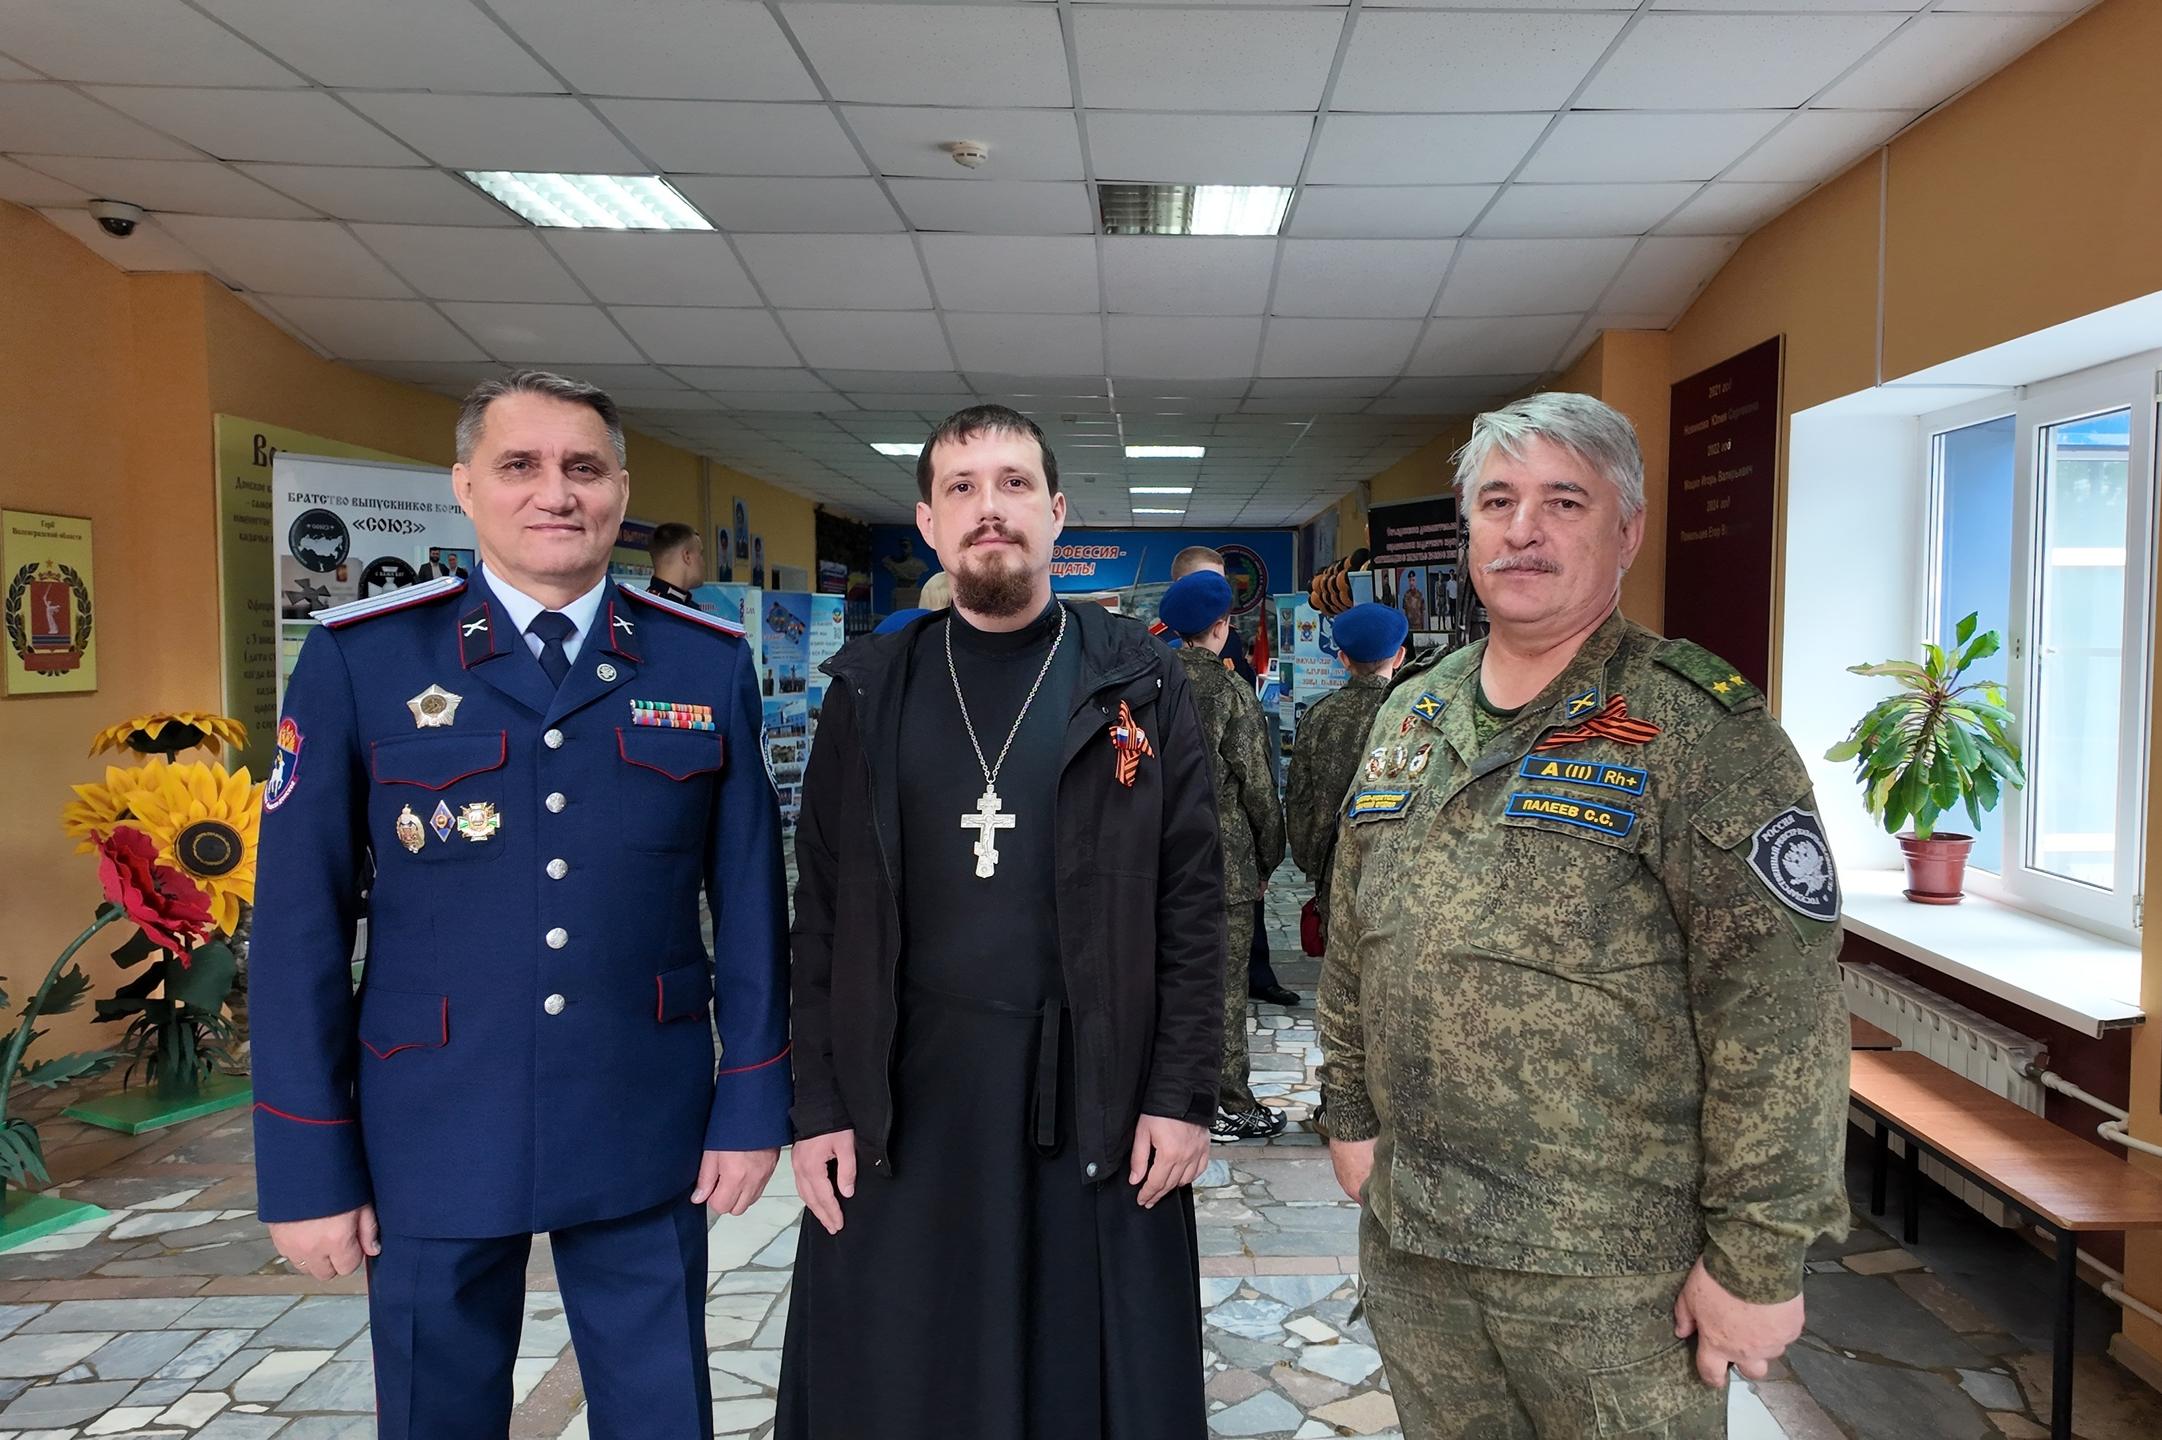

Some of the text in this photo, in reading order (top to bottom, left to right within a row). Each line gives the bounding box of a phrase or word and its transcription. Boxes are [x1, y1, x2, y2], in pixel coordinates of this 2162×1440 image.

[287, 492, 349, 506] БРАТСТВО
[351, 497, 434, 512] ВЫПУСКНИКОВ
[352, 517, 426, 534] «СОЮЗ»
[1052, 546, 1119, 558] ОФЕССИЯ
[1050, 562, 1095, 576] ЩАТЬ!
[1604, 770, 1637, 786] Rh+
[1522, 799, 1614, 827] ПАЛЕЕВ С.С.
[1761, 814, 1796, 842] РОССИЯ
